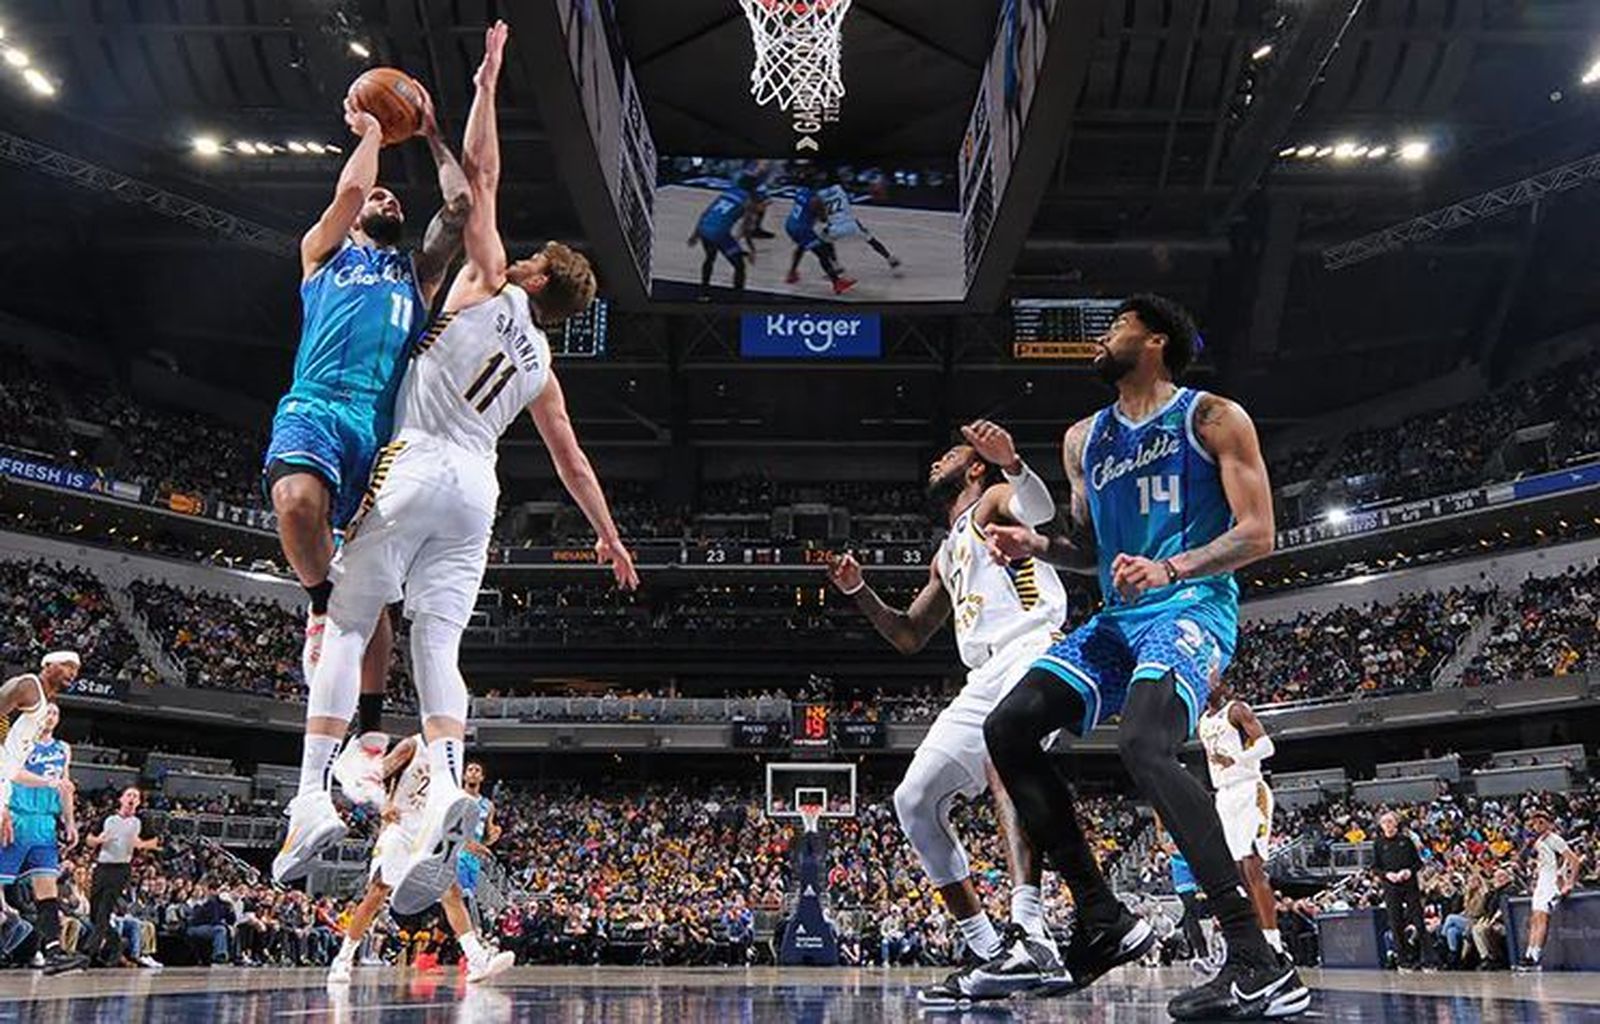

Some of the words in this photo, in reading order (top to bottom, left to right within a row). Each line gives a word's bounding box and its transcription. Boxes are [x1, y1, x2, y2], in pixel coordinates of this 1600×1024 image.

[391, 292, 413, 333] 11
[766, 313, 861, 351] Kroger
[464, 351, 518, 415] 11
[66, 472, 84, 488] IS
[1091, 433, 1181, 491] Charlotte
[1137, 475, 1180, 514] 14
[706, 550, 725, 563] 23
[903, 550, 921, 563] 33
